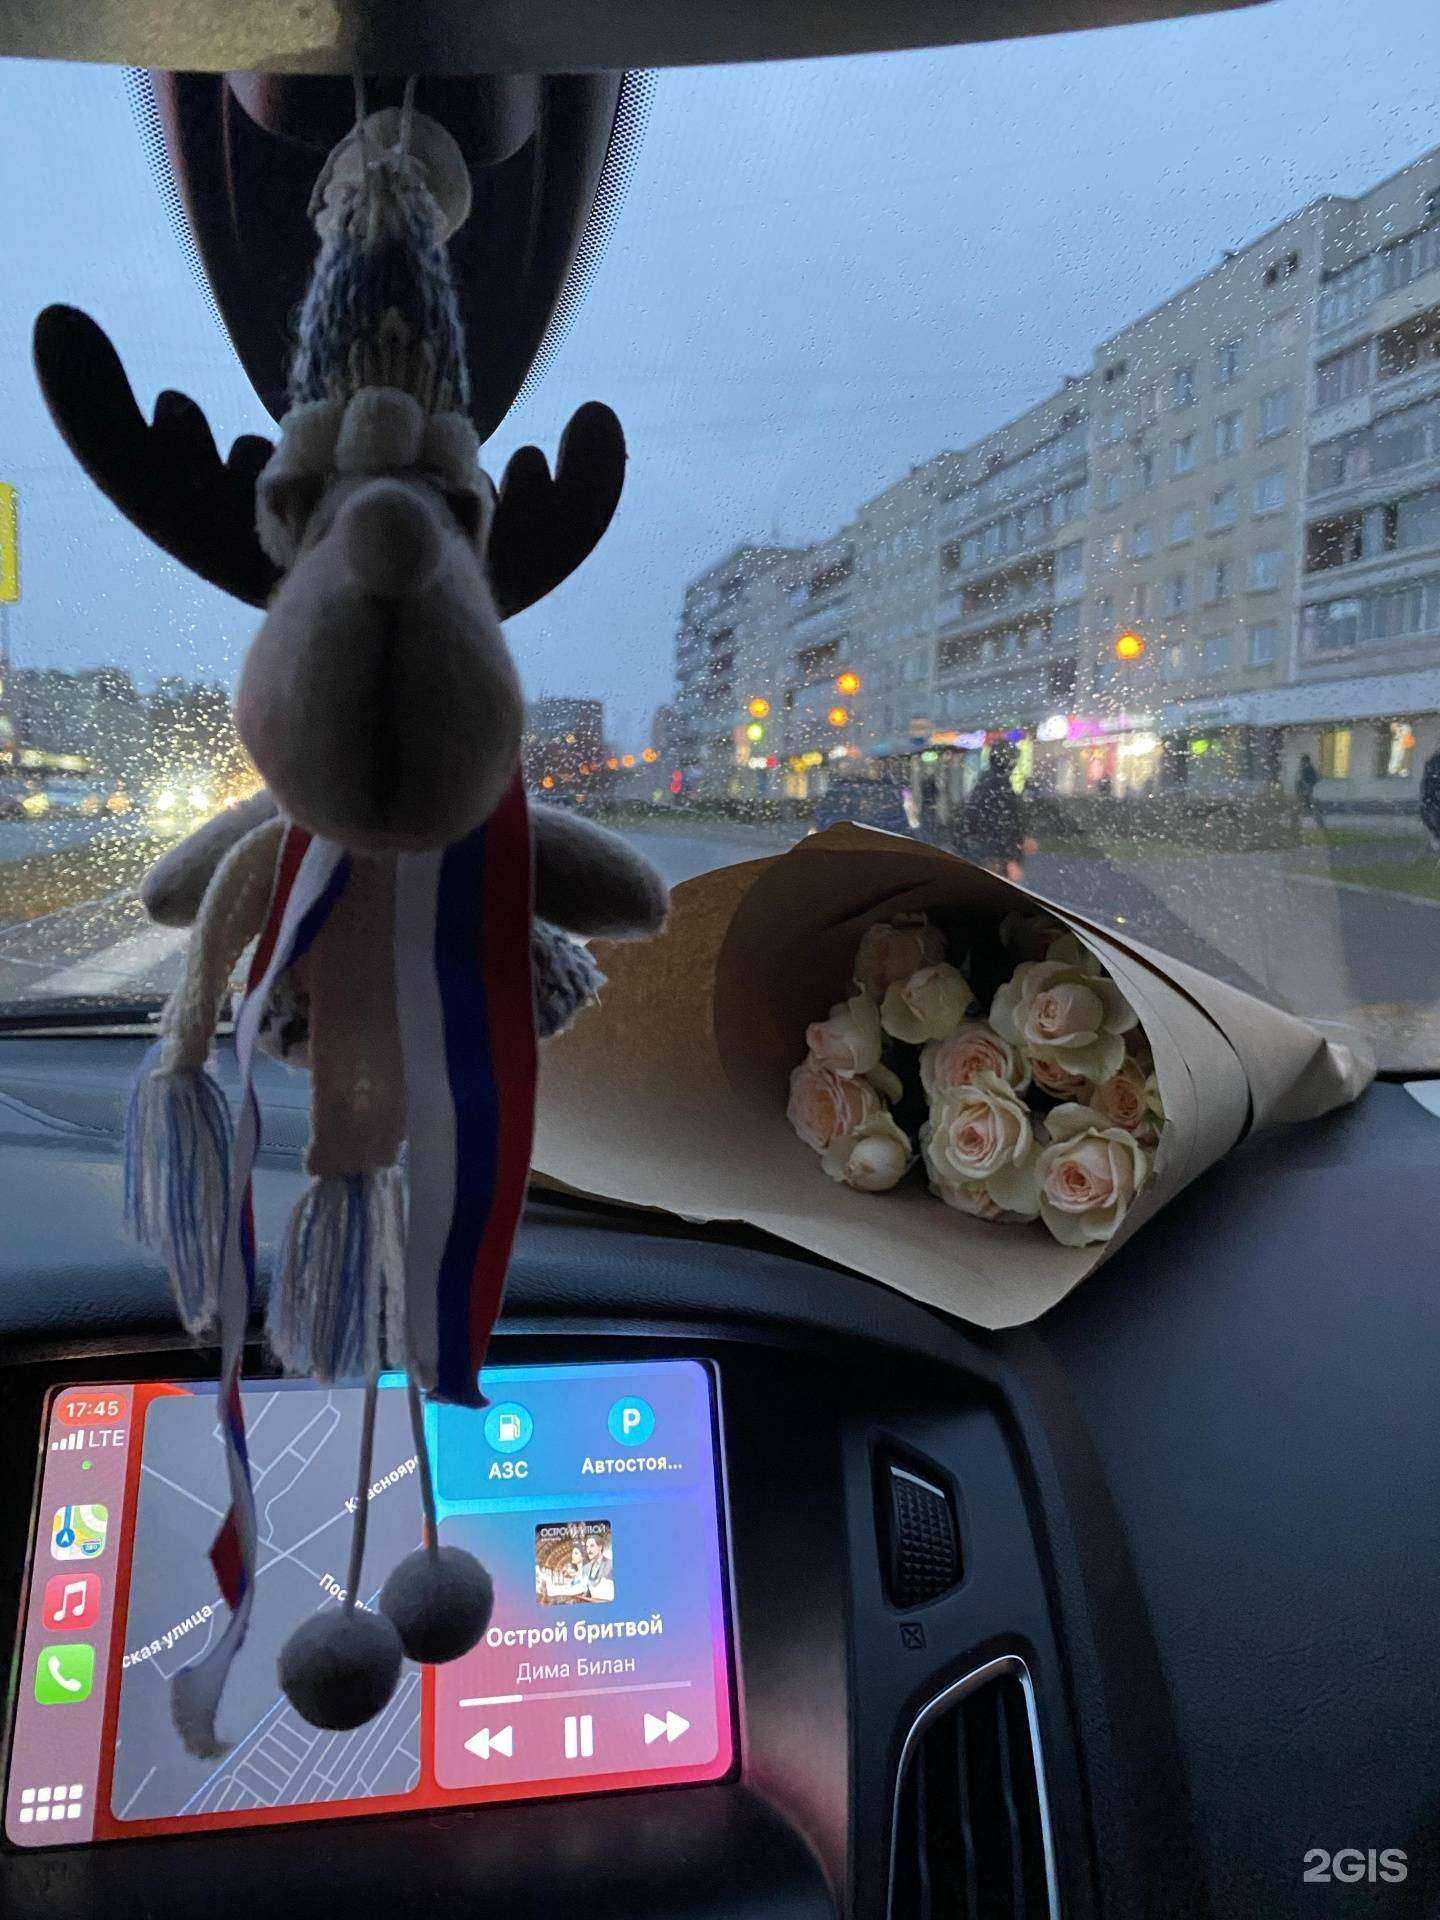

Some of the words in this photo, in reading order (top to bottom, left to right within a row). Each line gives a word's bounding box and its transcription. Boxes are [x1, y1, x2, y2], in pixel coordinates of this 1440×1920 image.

[66, 1400, 119, 1418] 17:45
[88, 1429, 126, 1448] LTE
[488, 1460, 529, 1480] АЗС
[344, 1455, 420, 1514] Каснояр
[122, 1639, 162, 1669] ская
[162, 1605, 213, 1649] улица
[486, 1621, 568, 1648] Острой
[573, 1614, 664, 1643] бритвой
[516, 1663, 570, 1684] Дима
[577, 1657, 635, 1677] Билан
